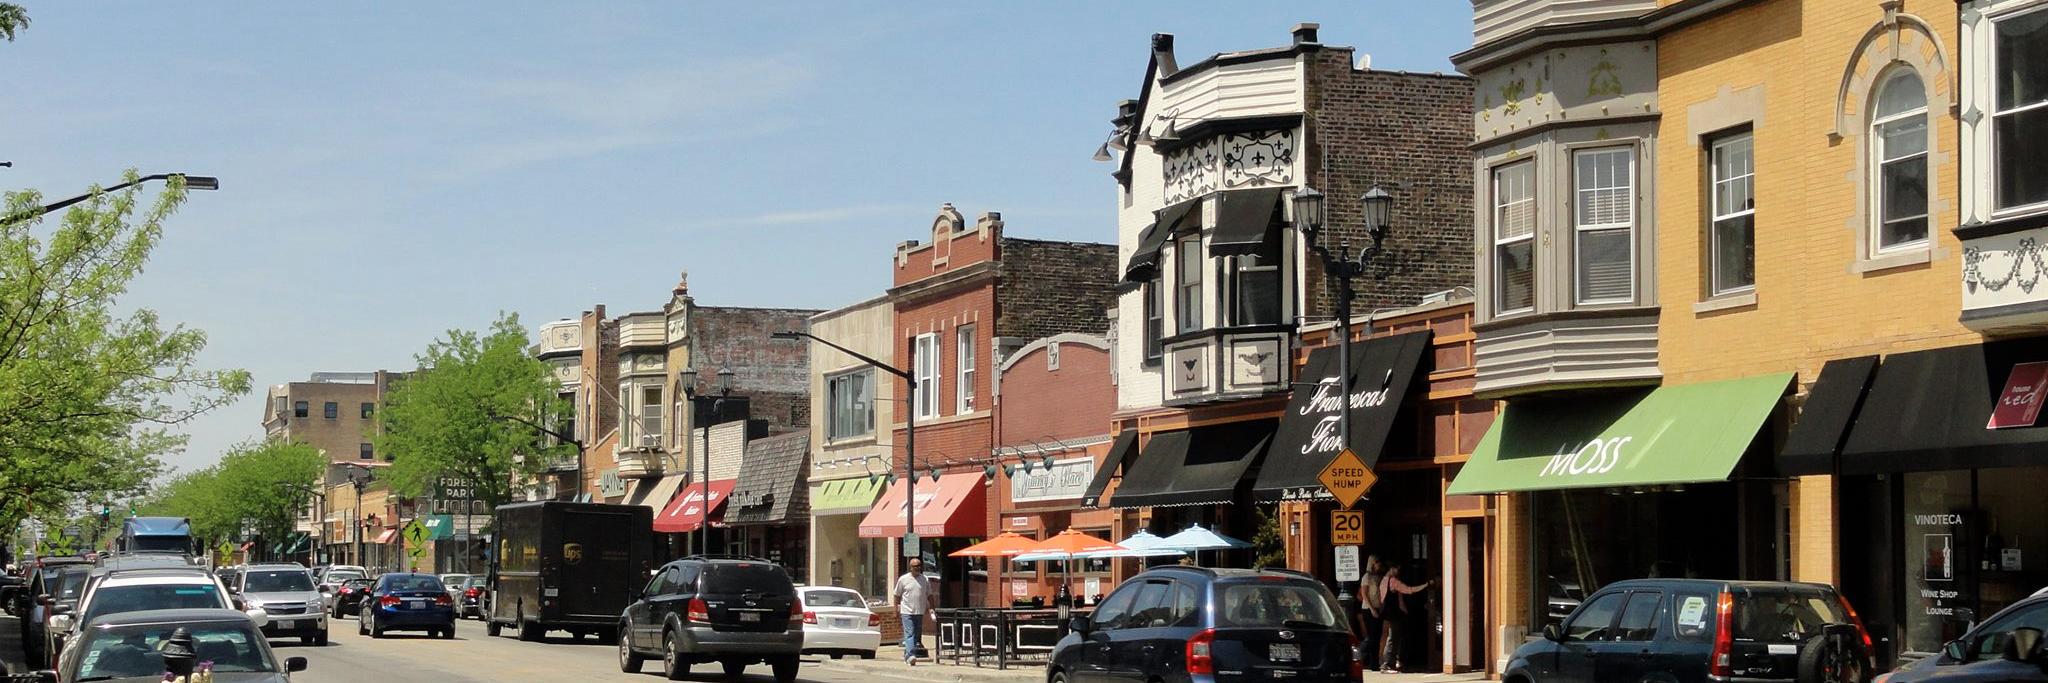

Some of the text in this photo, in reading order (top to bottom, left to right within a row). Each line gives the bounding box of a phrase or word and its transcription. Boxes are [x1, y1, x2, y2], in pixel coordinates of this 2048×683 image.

[1300, 368, 1392, 415] Franesca's
[1301, 416, 1342, 455] Fior
[1540, 436, 1632, 477] MOSS
[1332, 468, 1364, 477] SPEED
[1333, 480, 1362, 489] HUMP
[1335, 515, 1361, 531] 20
[1914, 514, 1963, 525] VINOTECA
[1926, 607, 1953, 616] LOUNGE
